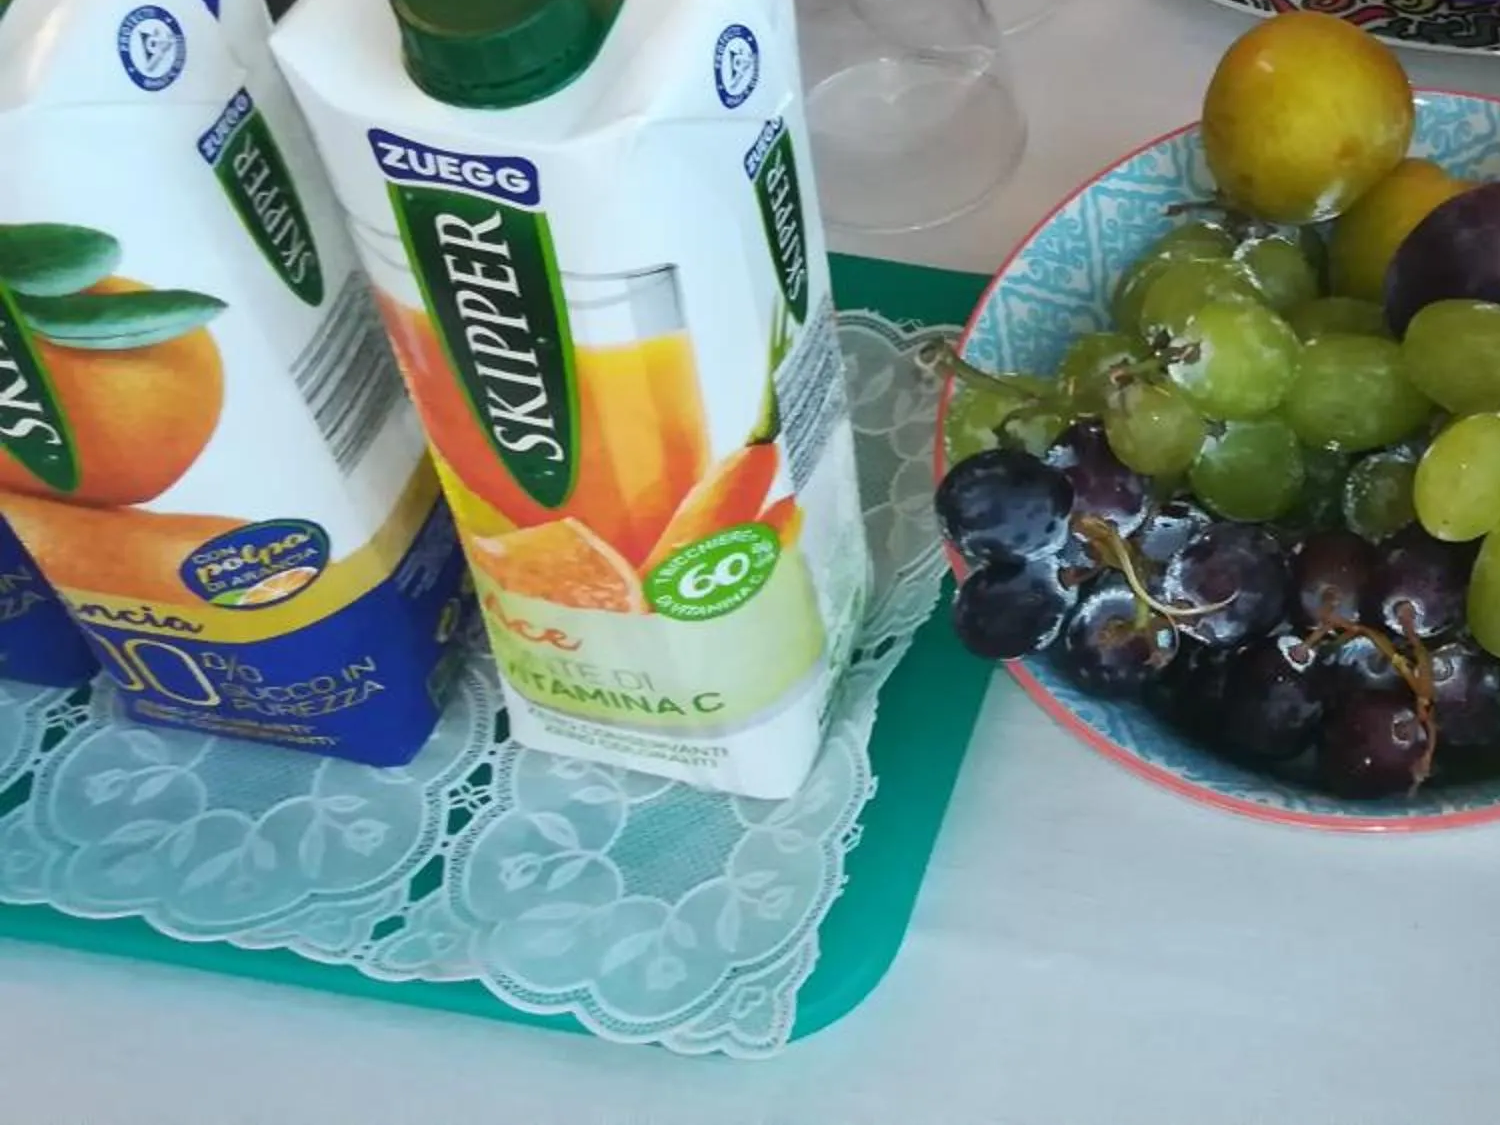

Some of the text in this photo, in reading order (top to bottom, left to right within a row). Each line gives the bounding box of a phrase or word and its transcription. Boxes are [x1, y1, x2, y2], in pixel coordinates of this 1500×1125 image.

[377, 141, 531, 194] ZUEGG
[233, 131, 312, 285] SKIPPER
[765, 149, 807, 301] SKIPPER
[434, 208, 566, 463] SKIPPER
[191, 545, 237, 565] CON
[196, 532, 312, 585] polpa
[678, 551, 751, 600] 60
[76, 603, 205, 634] ncia
[219, 655, 377, 702] SUCCO IN
[232, 679, 386, 717] PUREZZA
[612, 670, 656, 693] DI
[693, 691, 726, 714] C
